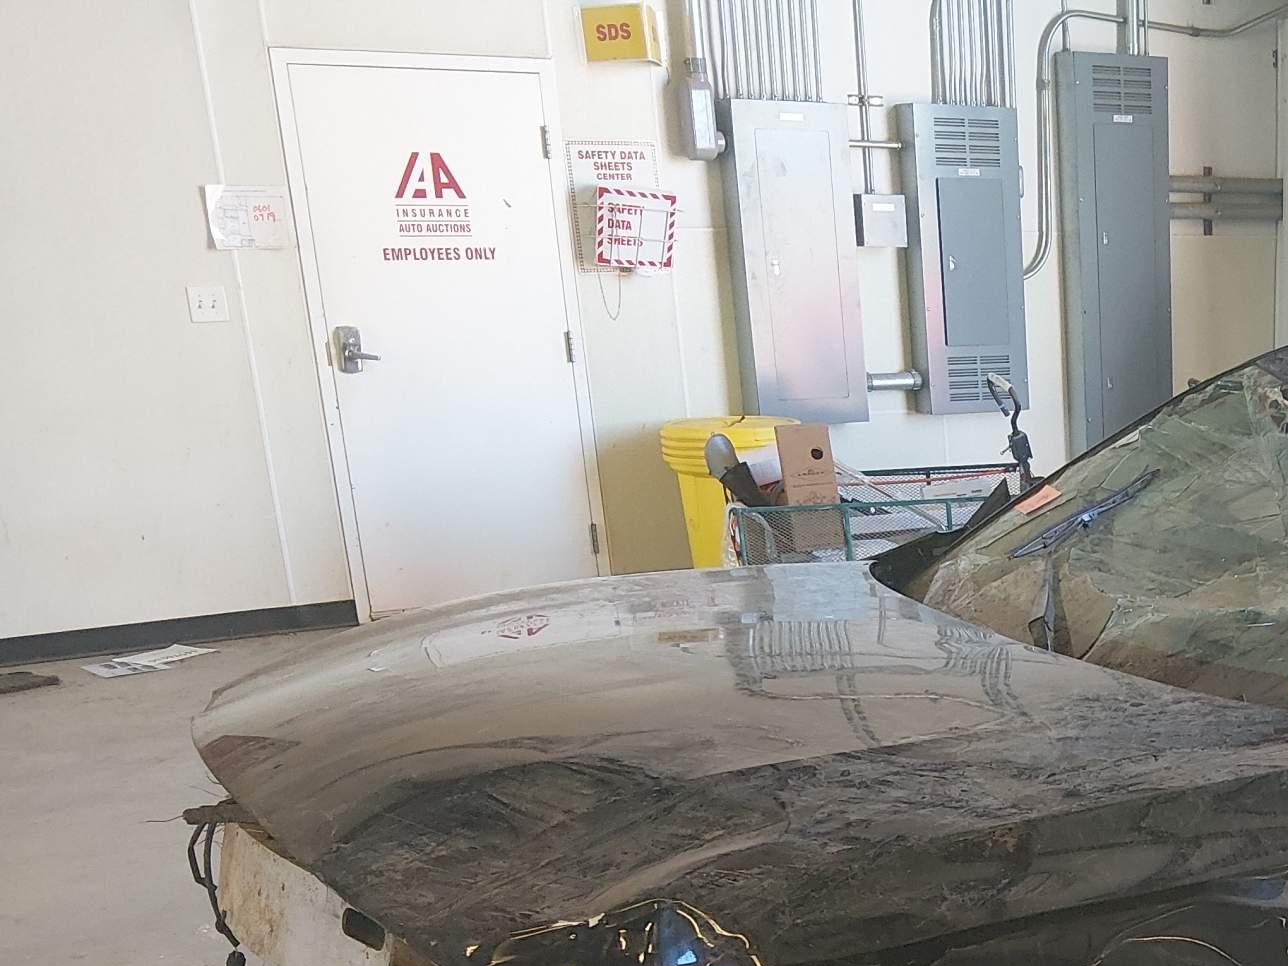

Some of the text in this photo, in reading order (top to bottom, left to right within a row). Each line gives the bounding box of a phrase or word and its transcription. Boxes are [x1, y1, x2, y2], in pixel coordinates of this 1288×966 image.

[596, 22, 631, 41] SDS
[577, 150, 646, 160] SAFETY DATA
[593, 161, 633, 171] SHEETS
[396, 208, 470, 218] INSURANCE
[399, 223, 471, 233] AUTO AUCTIONS
[607, 218, 632, 230] DATA
[383, 247, 496, 261] EMPLOYEES ONLY
